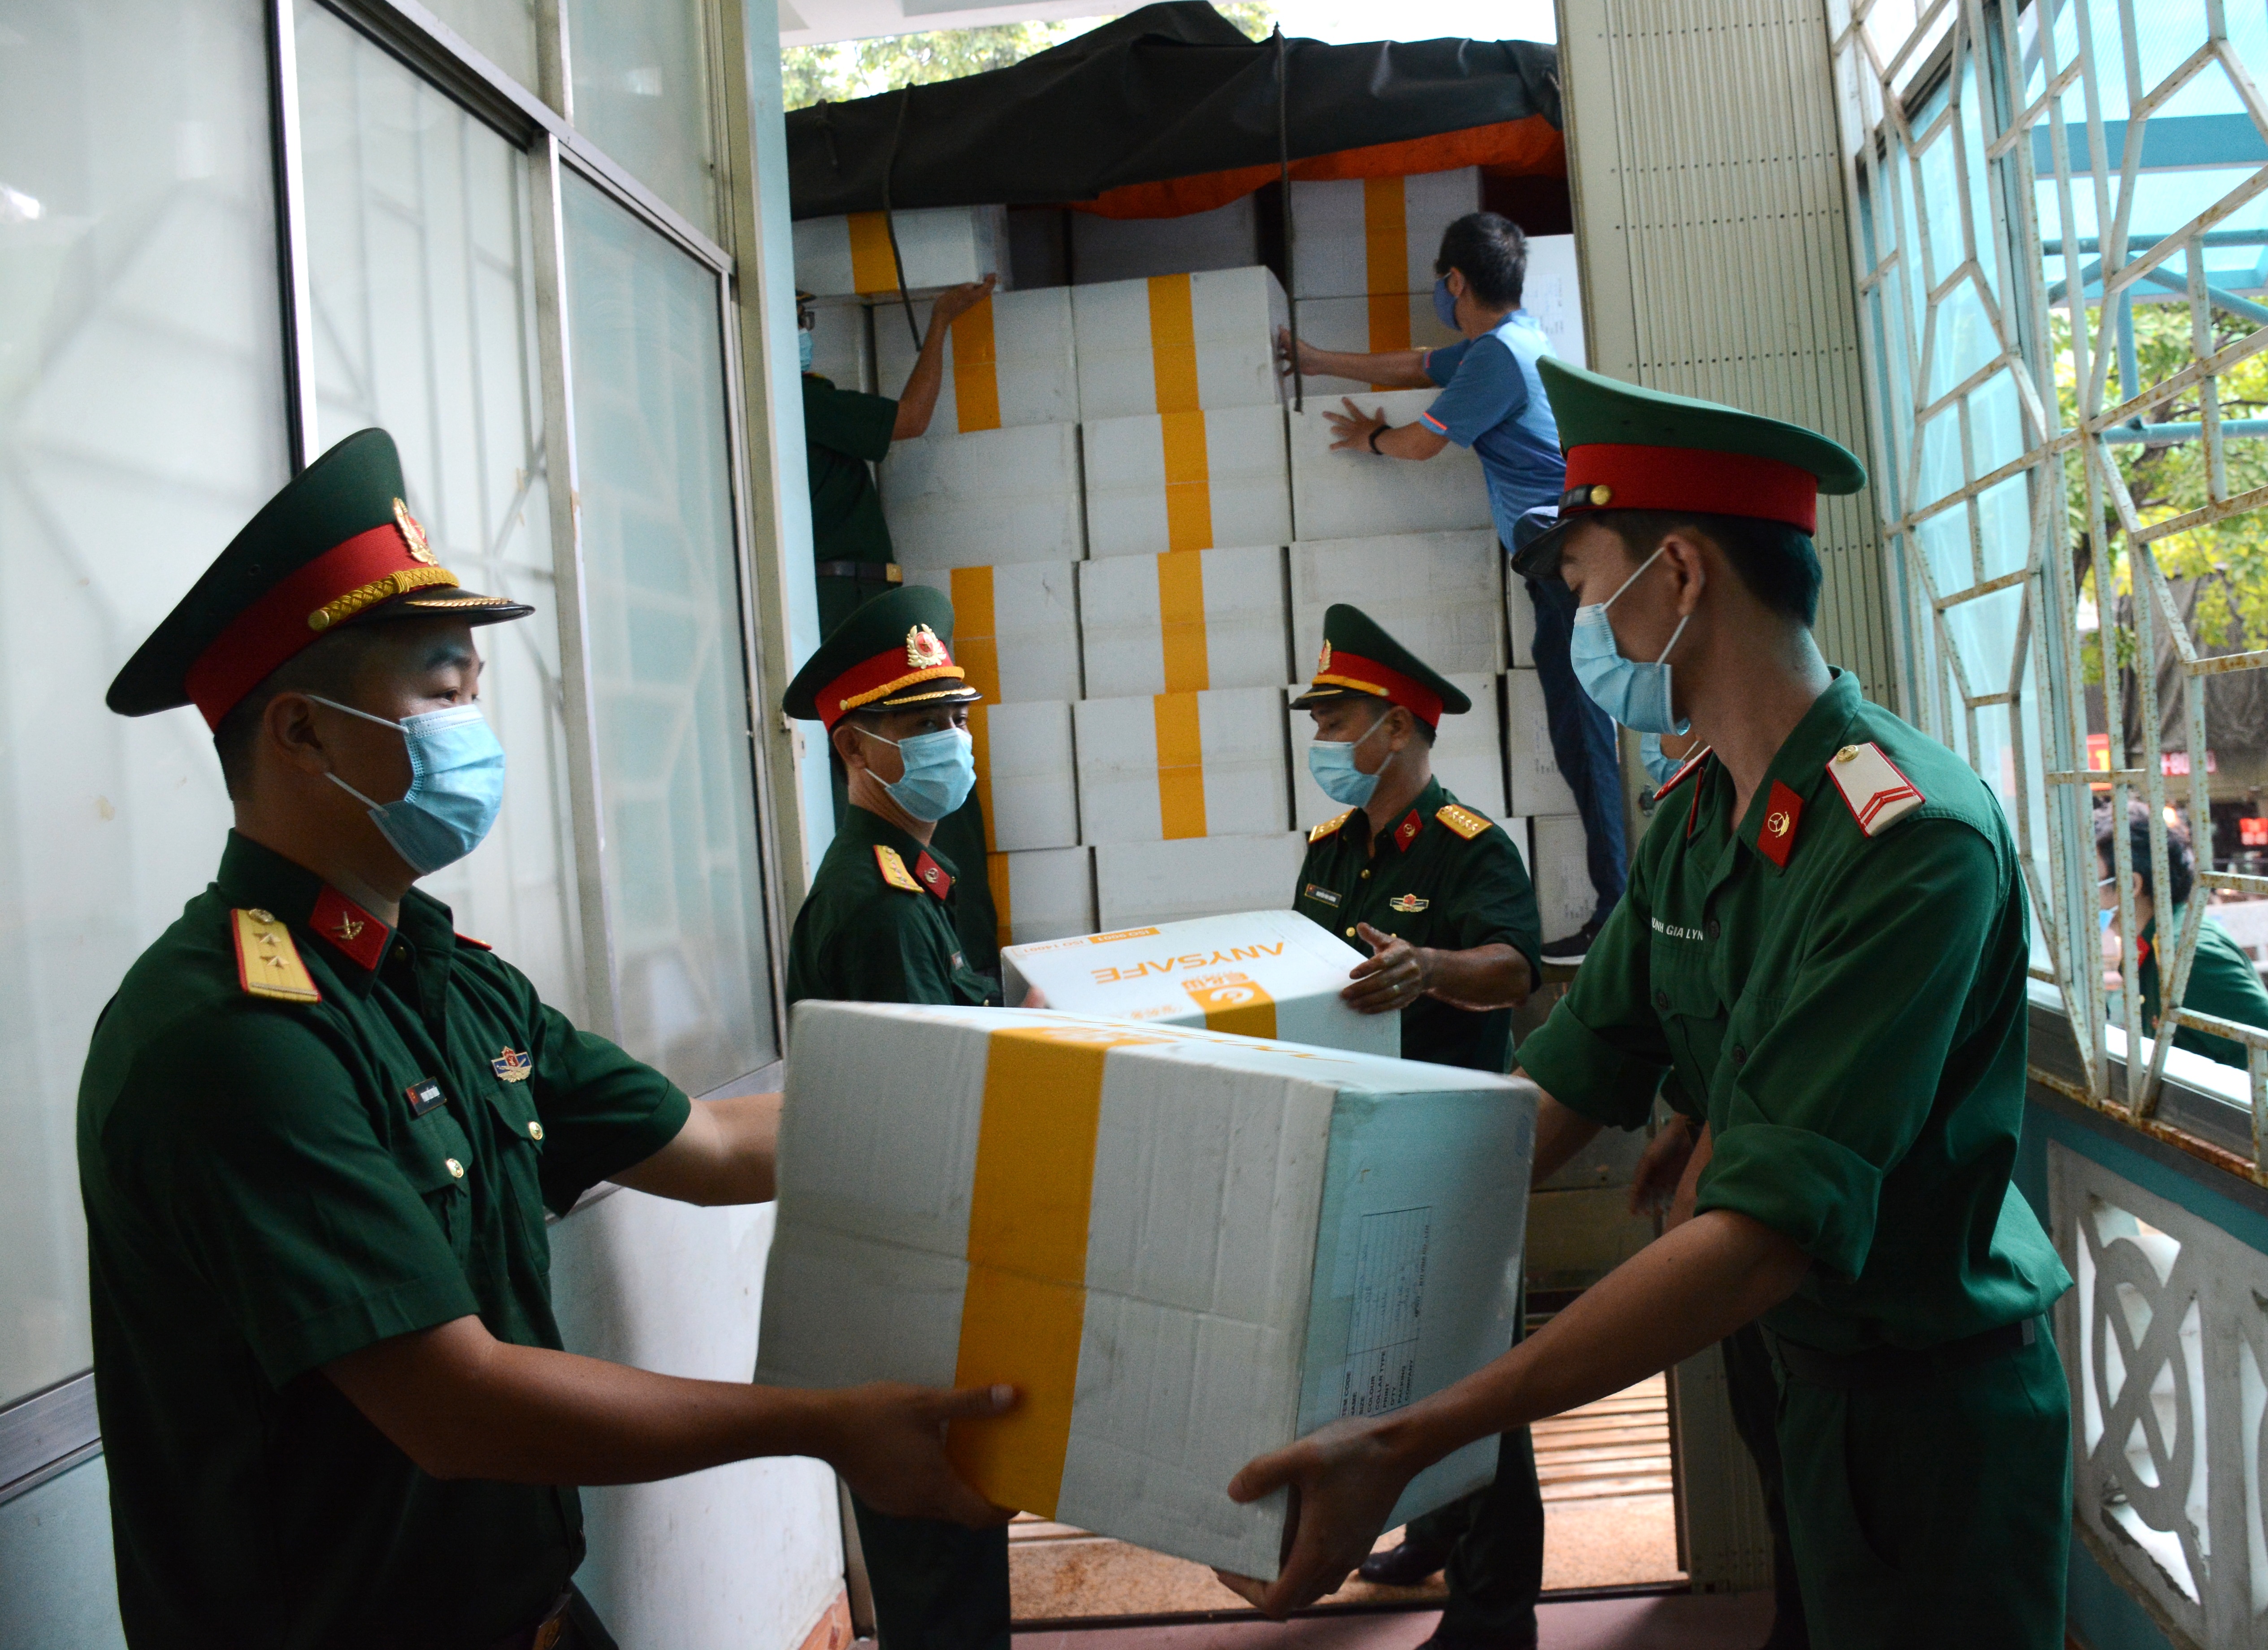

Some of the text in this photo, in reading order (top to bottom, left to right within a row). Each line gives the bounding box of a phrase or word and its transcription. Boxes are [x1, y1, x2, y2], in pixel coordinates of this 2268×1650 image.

[1652, 917, 1664, 933] UNH
[1666, 925, 1683, 938] GIA
[1097, 933, 1127, 941] 9001
[1023, 944, 1058, 953] 14001
[1091, 942, 1284, 984] ANYSAFE
